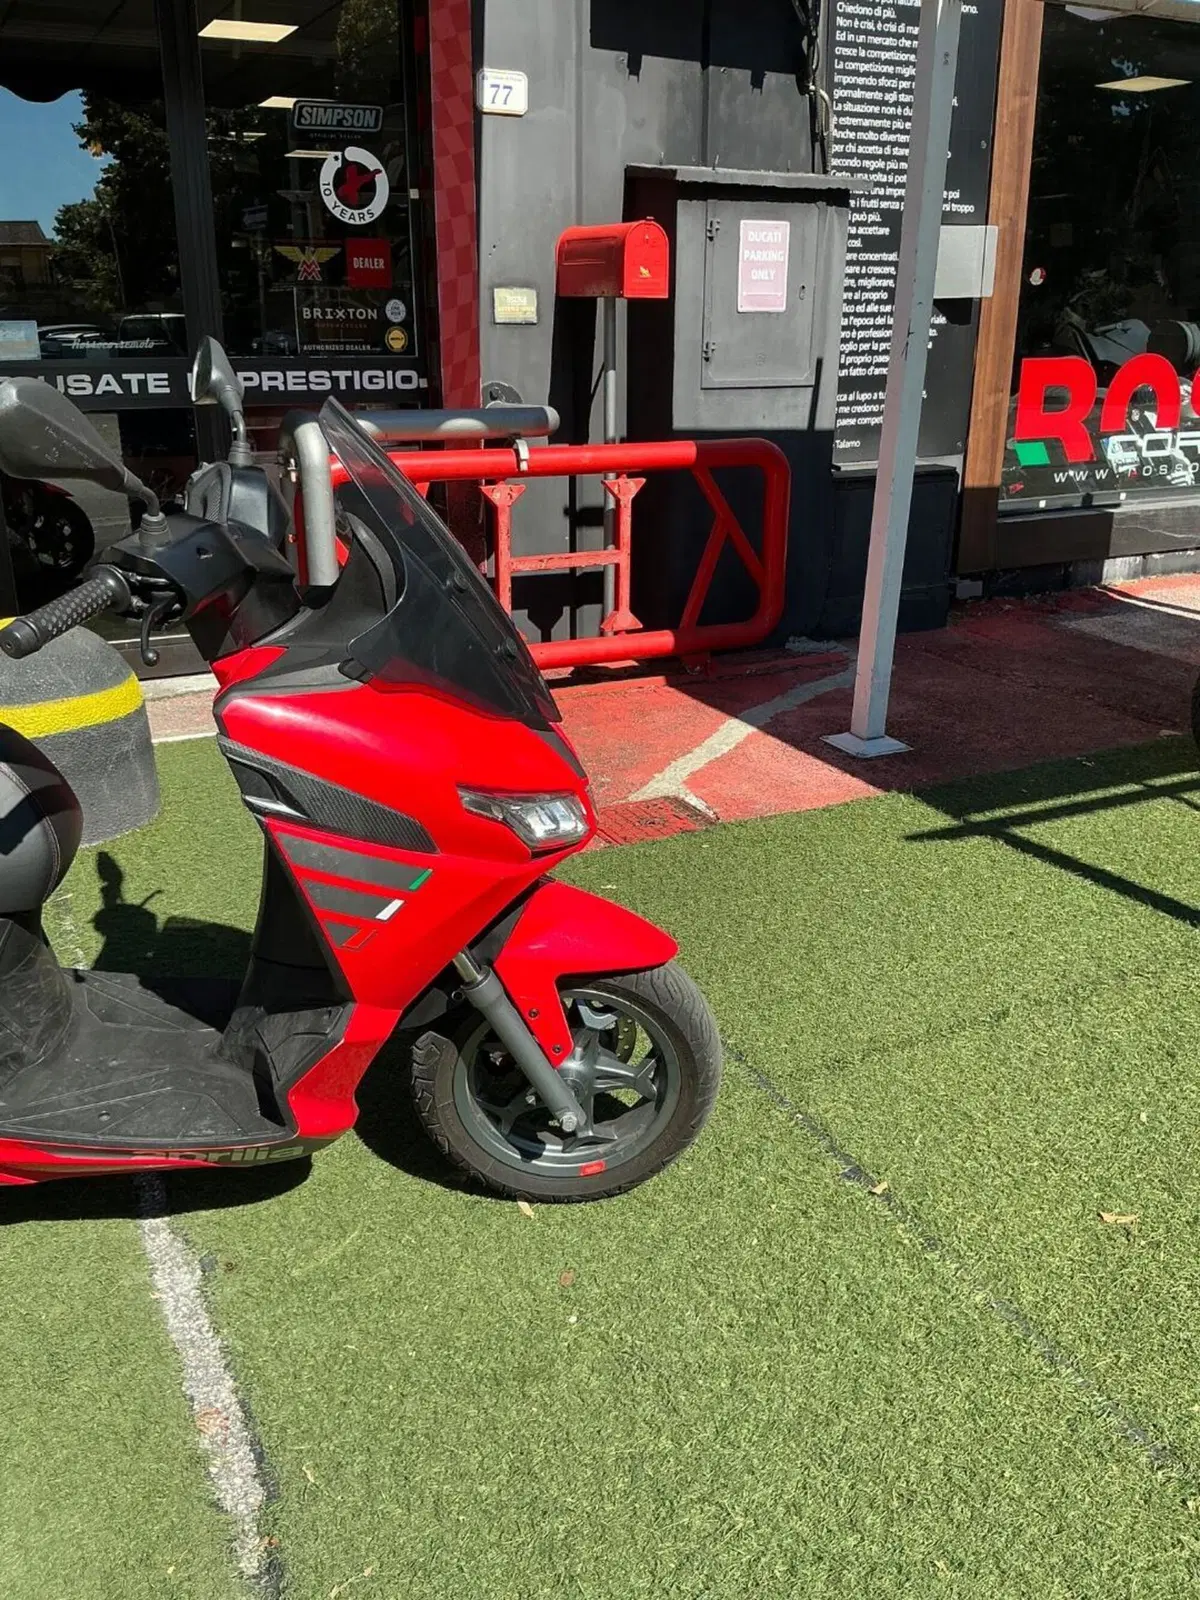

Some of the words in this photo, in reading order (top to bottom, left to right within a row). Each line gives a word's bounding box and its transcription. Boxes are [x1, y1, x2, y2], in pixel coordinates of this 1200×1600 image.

[837, 2, 873, 16] Chiedono
[874, 6, 882, 17] di
[882, 8, 897, 19] più.
[836, 16, 852, 27] Non
[860, 19, 876, 31] crisi,
[883, 22, 897, 32] crisi
[898, 23, 906, 33] di
[836, 30, 846, 41] Ed
[847, 31, 855, 42] in
[856, 35, 866, 43] un
[867, 35, 898, 46] mercato
[898, 37, 912, 48] che
[835, 46, 858, 57] cresce
[858, 46, 866, 57] la
[866, 49, 917, 62] competizione.
[834, 58, 844, 69] La
[844, 61, 895, 74] competizione
[834, 72, 878, 86] imponendo
[878, 76, 898, 88] sforzi
[898, 80, 912, 90] per
[490, 84, 513, 105] 77
[833, 87, 884, 100] giornalmente
[884, 91, 898, 104] agli
[898, 93, 914, 102] stan
[833, 100, 842, 111] La
[843, 101, 881, 113] situazione
[881, 106, 897, 116] non
[903, 106, 913, 116] du
[301, 106, 377, 128] SIMPSON
[839, 116, 892, 129] estremamente
[892, 118, 905, 131] più
[833, 128, 856, 140] Anche
[857, 130, 879, 141] molto
[832, 144, 844, 154] per
[845, 142, 857, 153] chi
[857, 145, 883, 154] accetta
[883, 145, 891, 155] di
[831, 156, 861, 167] secondo
[862, 158, 886, 171] regole
[886, 159, 899, 171] più
[869, 172, 887, 182] volta
[888, 172, 894, 182] si
[322, 181, 333, 197] 10
[331, 201, 375, 222] YEARS
[948, 189, 960, 201] poi
[860, 197, 880, 208] frutti
[880, 200, 900, 209] senza
[951, 203, 975, 214] troppo
[852, 211, 867, 223] può
[867, 212, 882, 224] più.
[748, 231, 782, 243] DUCATI
[857, 226, 890, 235] accettare
[743, 250, 785, 262] PARKING
[858, 252, 899, 261] concentrati.
[353, 257, 385, 269] DEALER
[751, 268, 777, 281] ONLY
[867, 266, 896, 276] crescere,
[857, 276, 895, 289] migliorare,
[854, 290, 861, 300] al
[861, 290, 888, 301] proprio
[302, 307, 379, 320] BRIXTON
[855, 303, 866, 312] ed
[866, 302, 879, 313] alle
[857, 328, 893, 340] profession
[840, 341, 858, 353] oglio
[859, 342, 871, 353] per
[872, 340, 879, 350] la
[846, 353, 872, 366] proprio
[838, 369, 848, 377] un
[849, 366, 867, 376] fatto
[238, 370, 428, 391] PRESTIGIO.
[848, 391, 856, 401] al
[856, 391, 872, 402] lupo
[838, 405, 850, 414] me
[851, 403, 878, 414] credono
[836, 416, 856, 428] paese
[857, 416, 883, 426] compet
